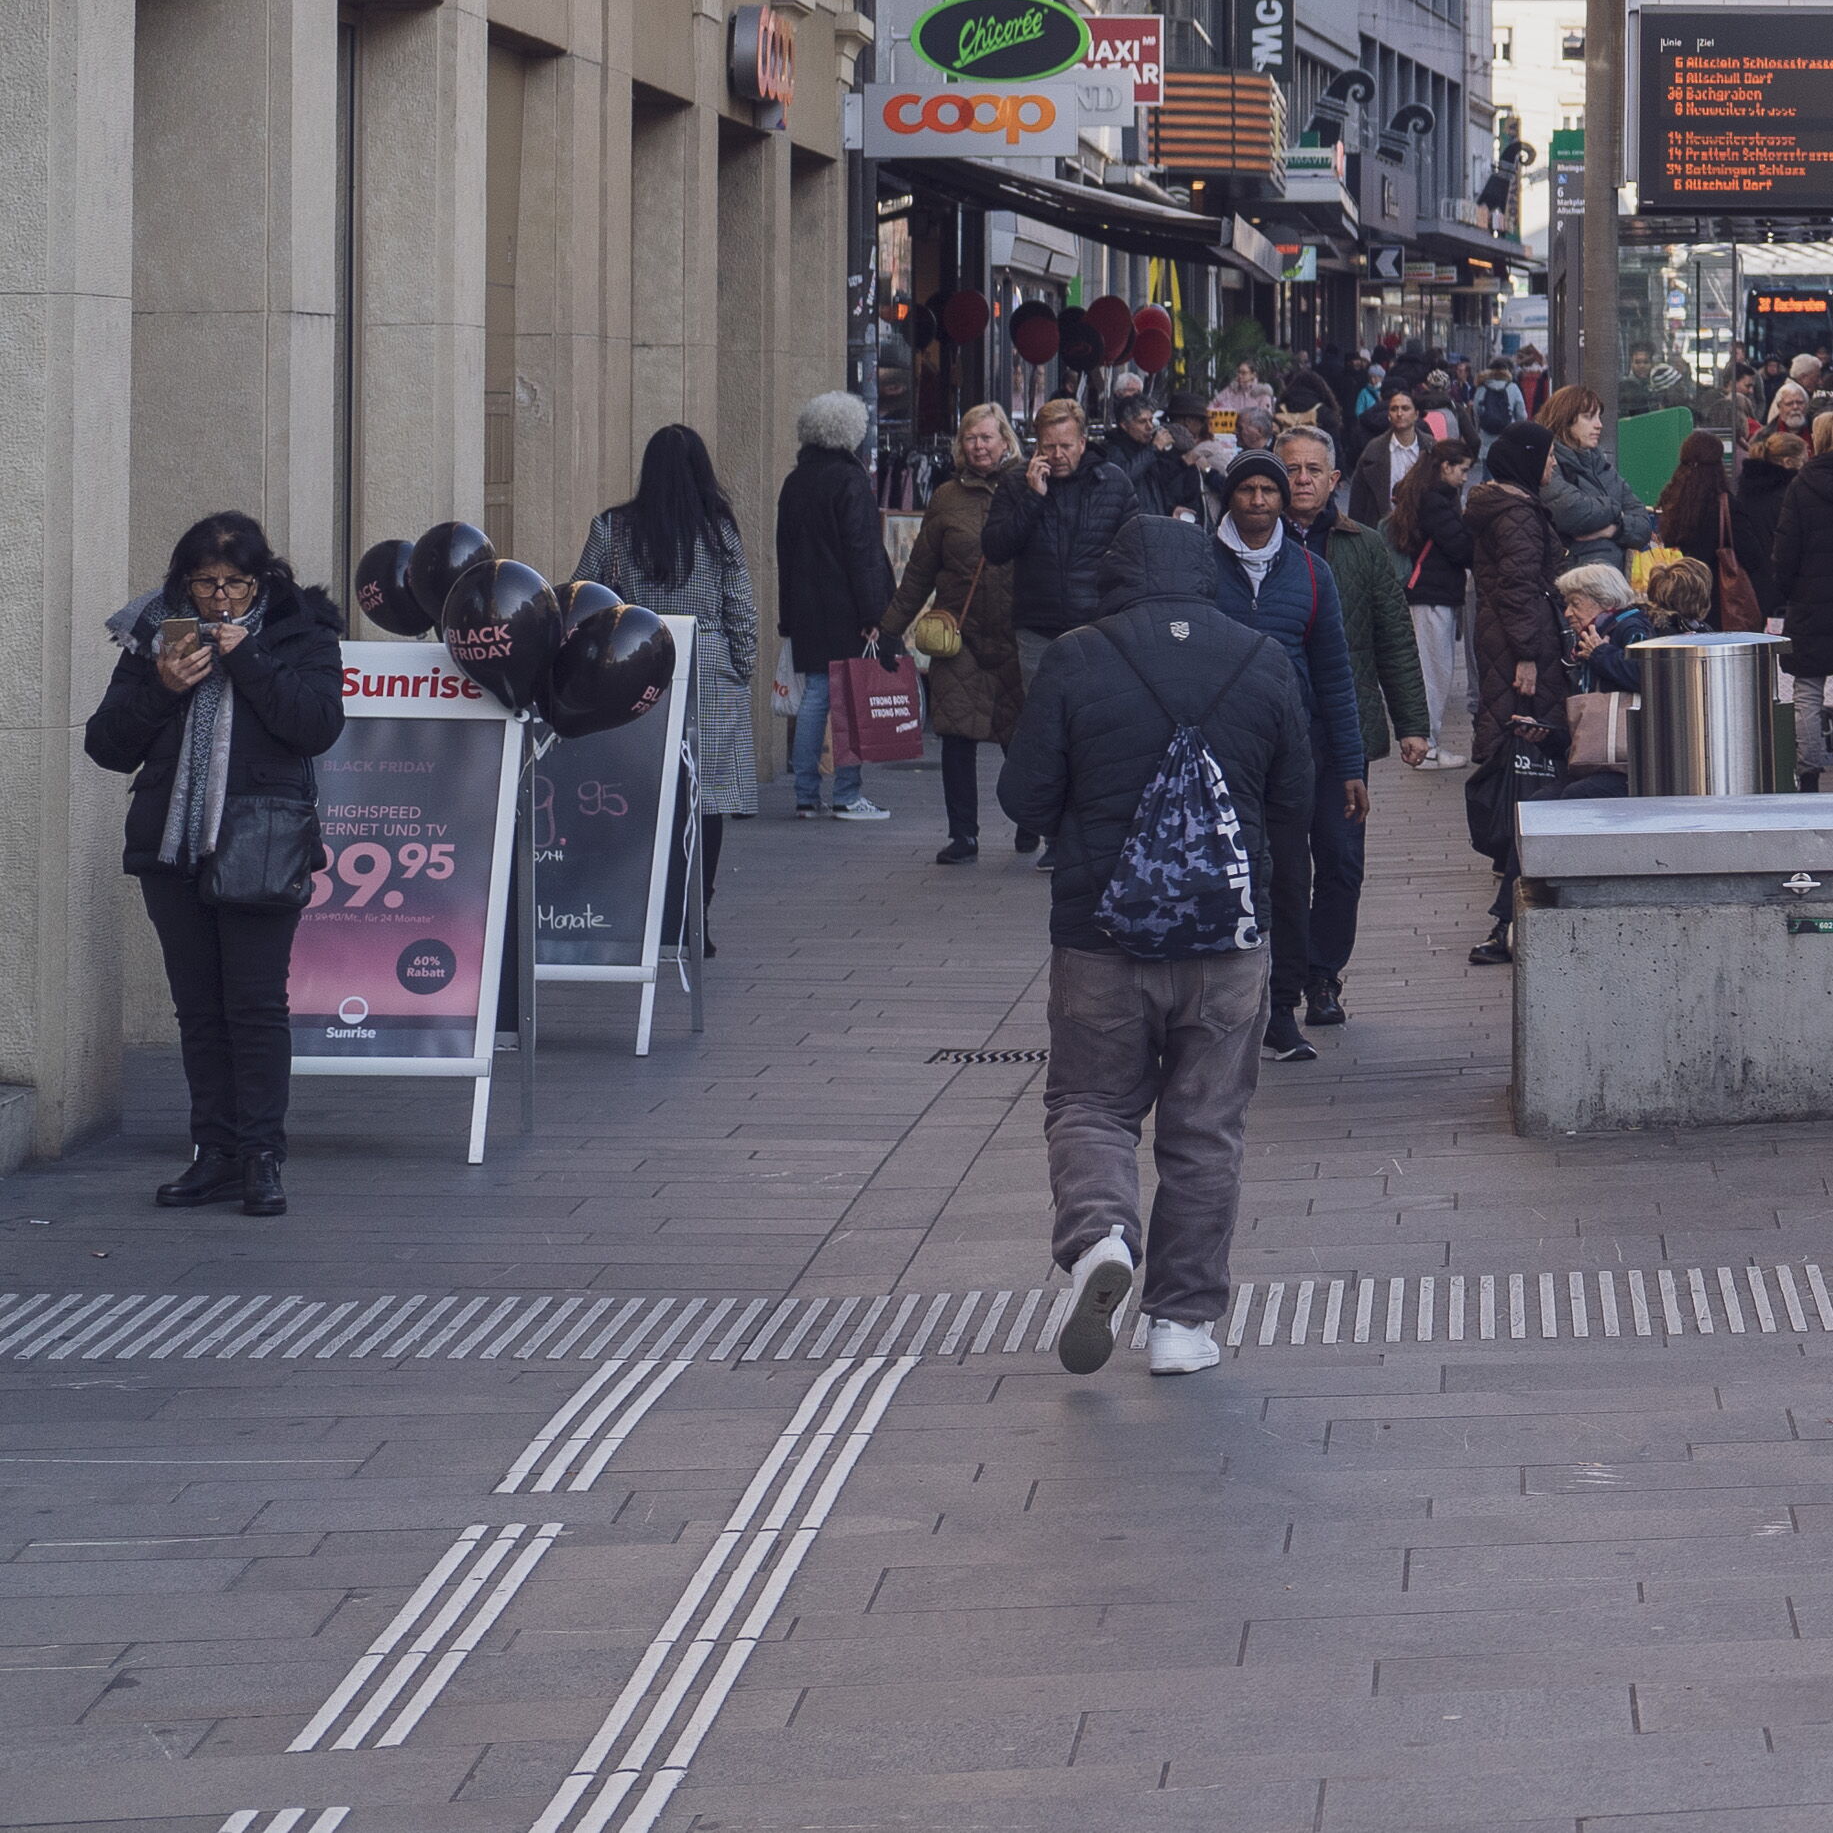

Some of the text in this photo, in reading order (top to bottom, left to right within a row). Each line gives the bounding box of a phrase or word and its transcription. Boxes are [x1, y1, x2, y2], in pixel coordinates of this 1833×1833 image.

[1662, 38, 1682, 47] Linie
[1699, 38, 1715, 47] Ziel
[882, 93, 1057, 145] coop
[1556, 187, 1564, 198] 6
[449, 623, 512, 644] BLACK
[452, 641, 514, 662] FRIDAY
[340, 666, 483, 700] Sunrise
[378, 760, 435, 774] FRIDAY
[326, 804, 422, 820] HIGHSPEED
[317, 821, 448, 838] TERNET UND TV
[537, 903, 613, 930] Monate
[413, 955, 441, 967] 60%
[406, 967, 446, 979] Rabatt
[325, 1026, 377, 1040] Sunrise
